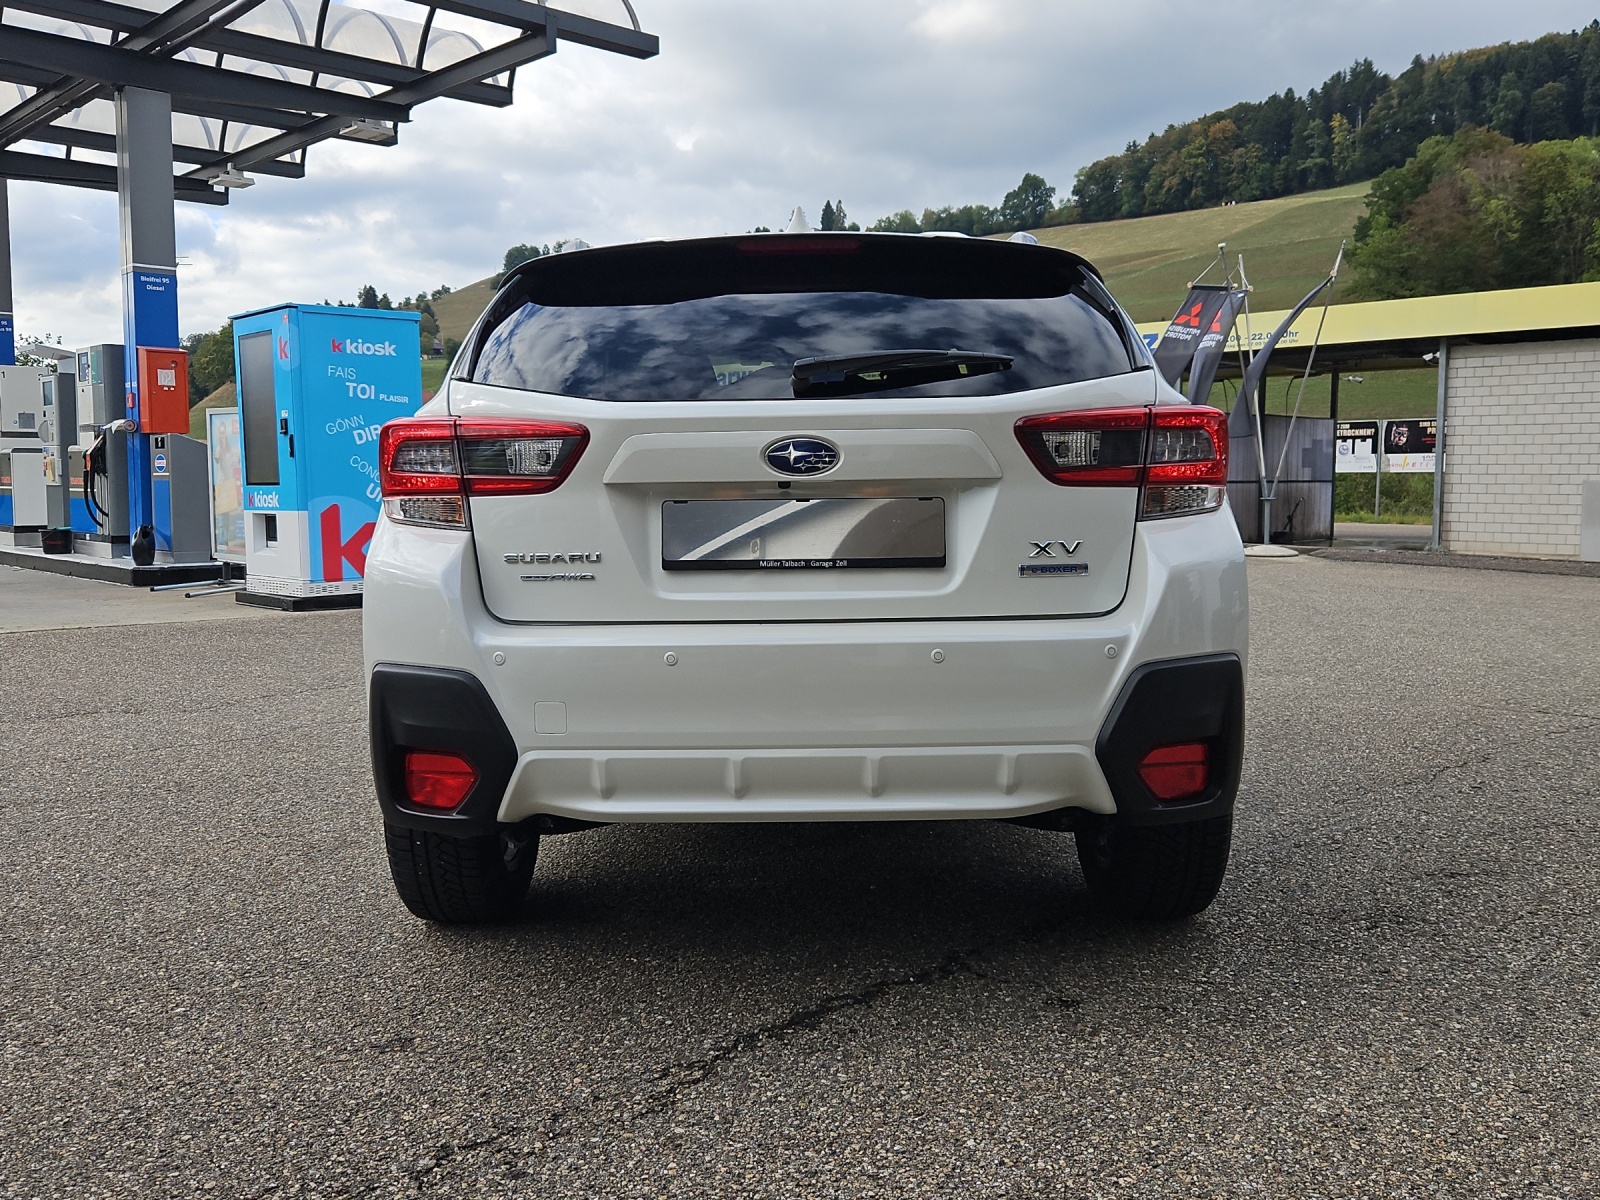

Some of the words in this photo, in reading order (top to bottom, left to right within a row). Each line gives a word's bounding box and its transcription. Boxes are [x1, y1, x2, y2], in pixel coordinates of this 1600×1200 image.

[140, 275, 162, 283] Bleifrei
[278, 335, 290, 360] k
[345, 338, 396, 356] kiosk
[0, 370, 6, 378] 1
[328, 365, 356, 380] FAIS
[345, 382, 375, 400] TOI
[380, 393, 409, 404] PLAISIR
[325, 414, 364, 434] GÖNN
[254, 490, 280, 508] kiosk
[320, 504, 376, 582] k
[1028, 540, 1083, 557] XV
[503, 552, 602, 564] SUBARU
[547, 572, 596, 581] AWD
[1031, 566, 1078, 574] e-BOXER
